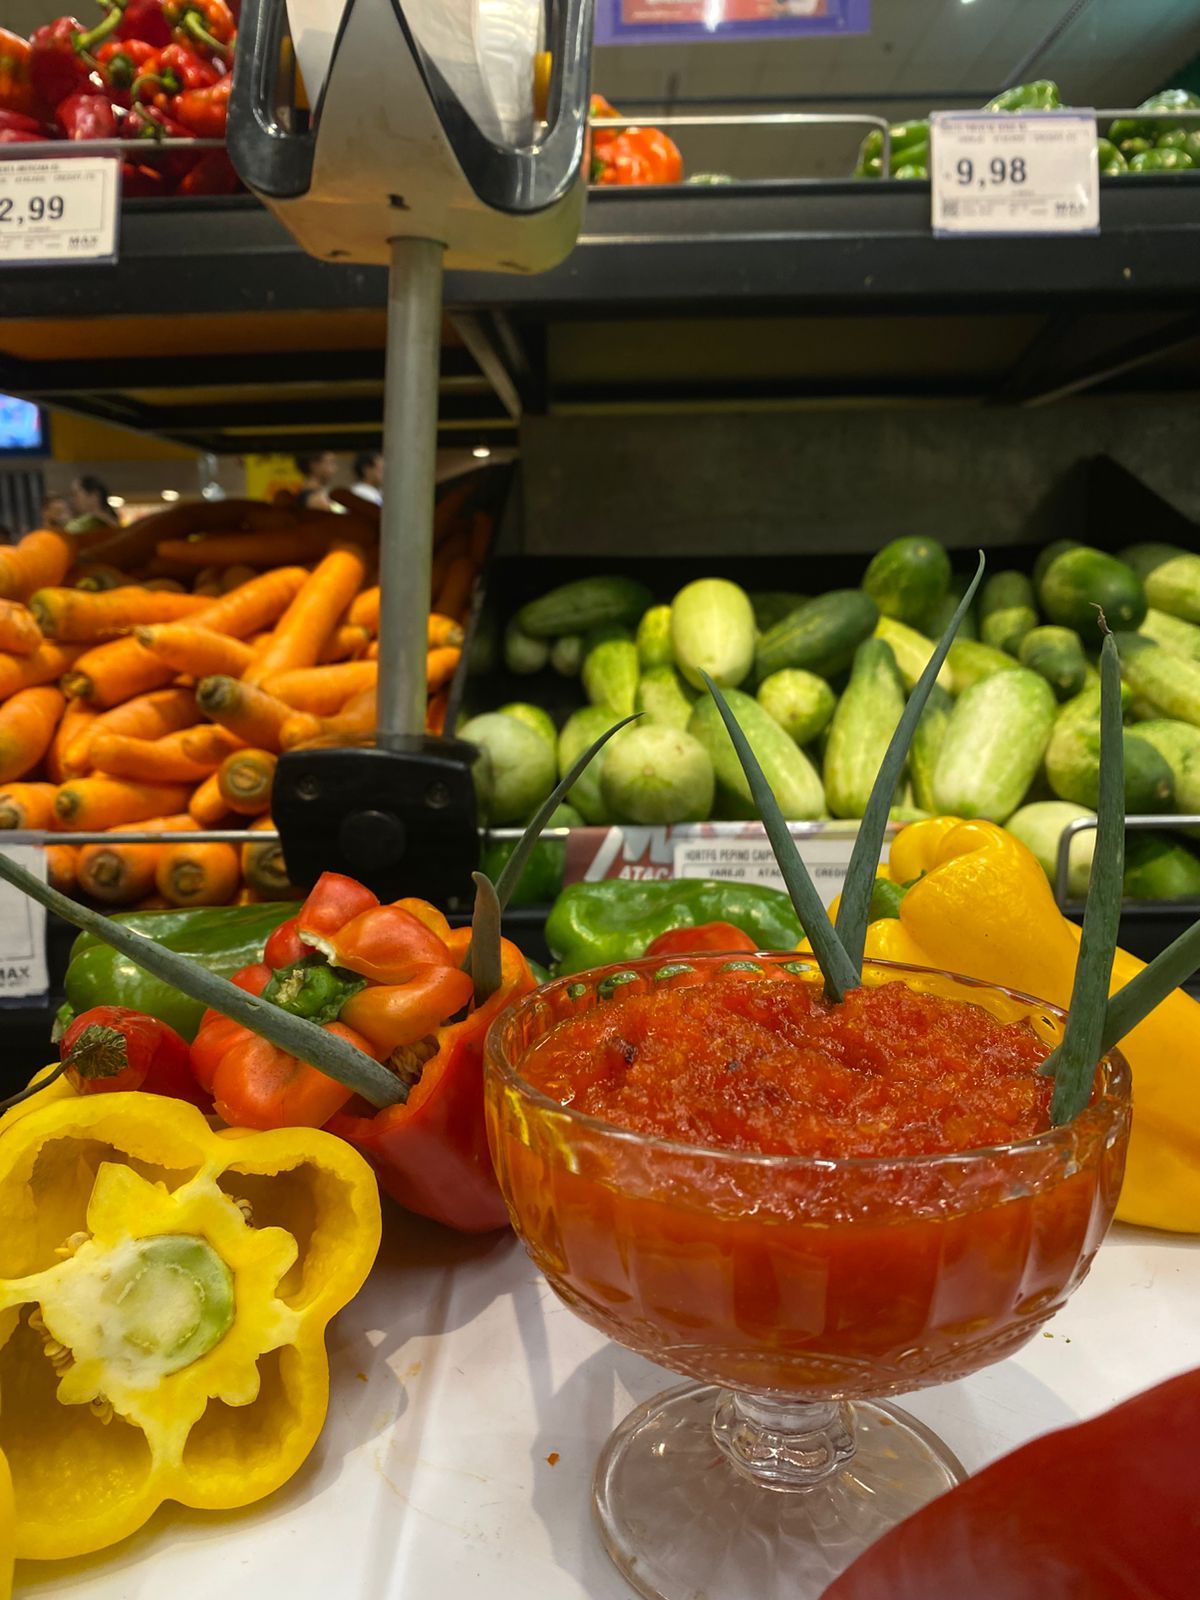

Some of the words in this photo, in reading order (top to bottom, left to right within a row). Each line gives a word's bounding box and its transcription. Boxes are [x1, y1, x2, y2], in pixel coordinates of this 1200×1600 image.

[957, 157, 1026, 188] 9,98
[0, 196, 64, 225] 2,99
[709, 867, 745, 877] VAREJO
[758, 867, 782, 877] ATAC
